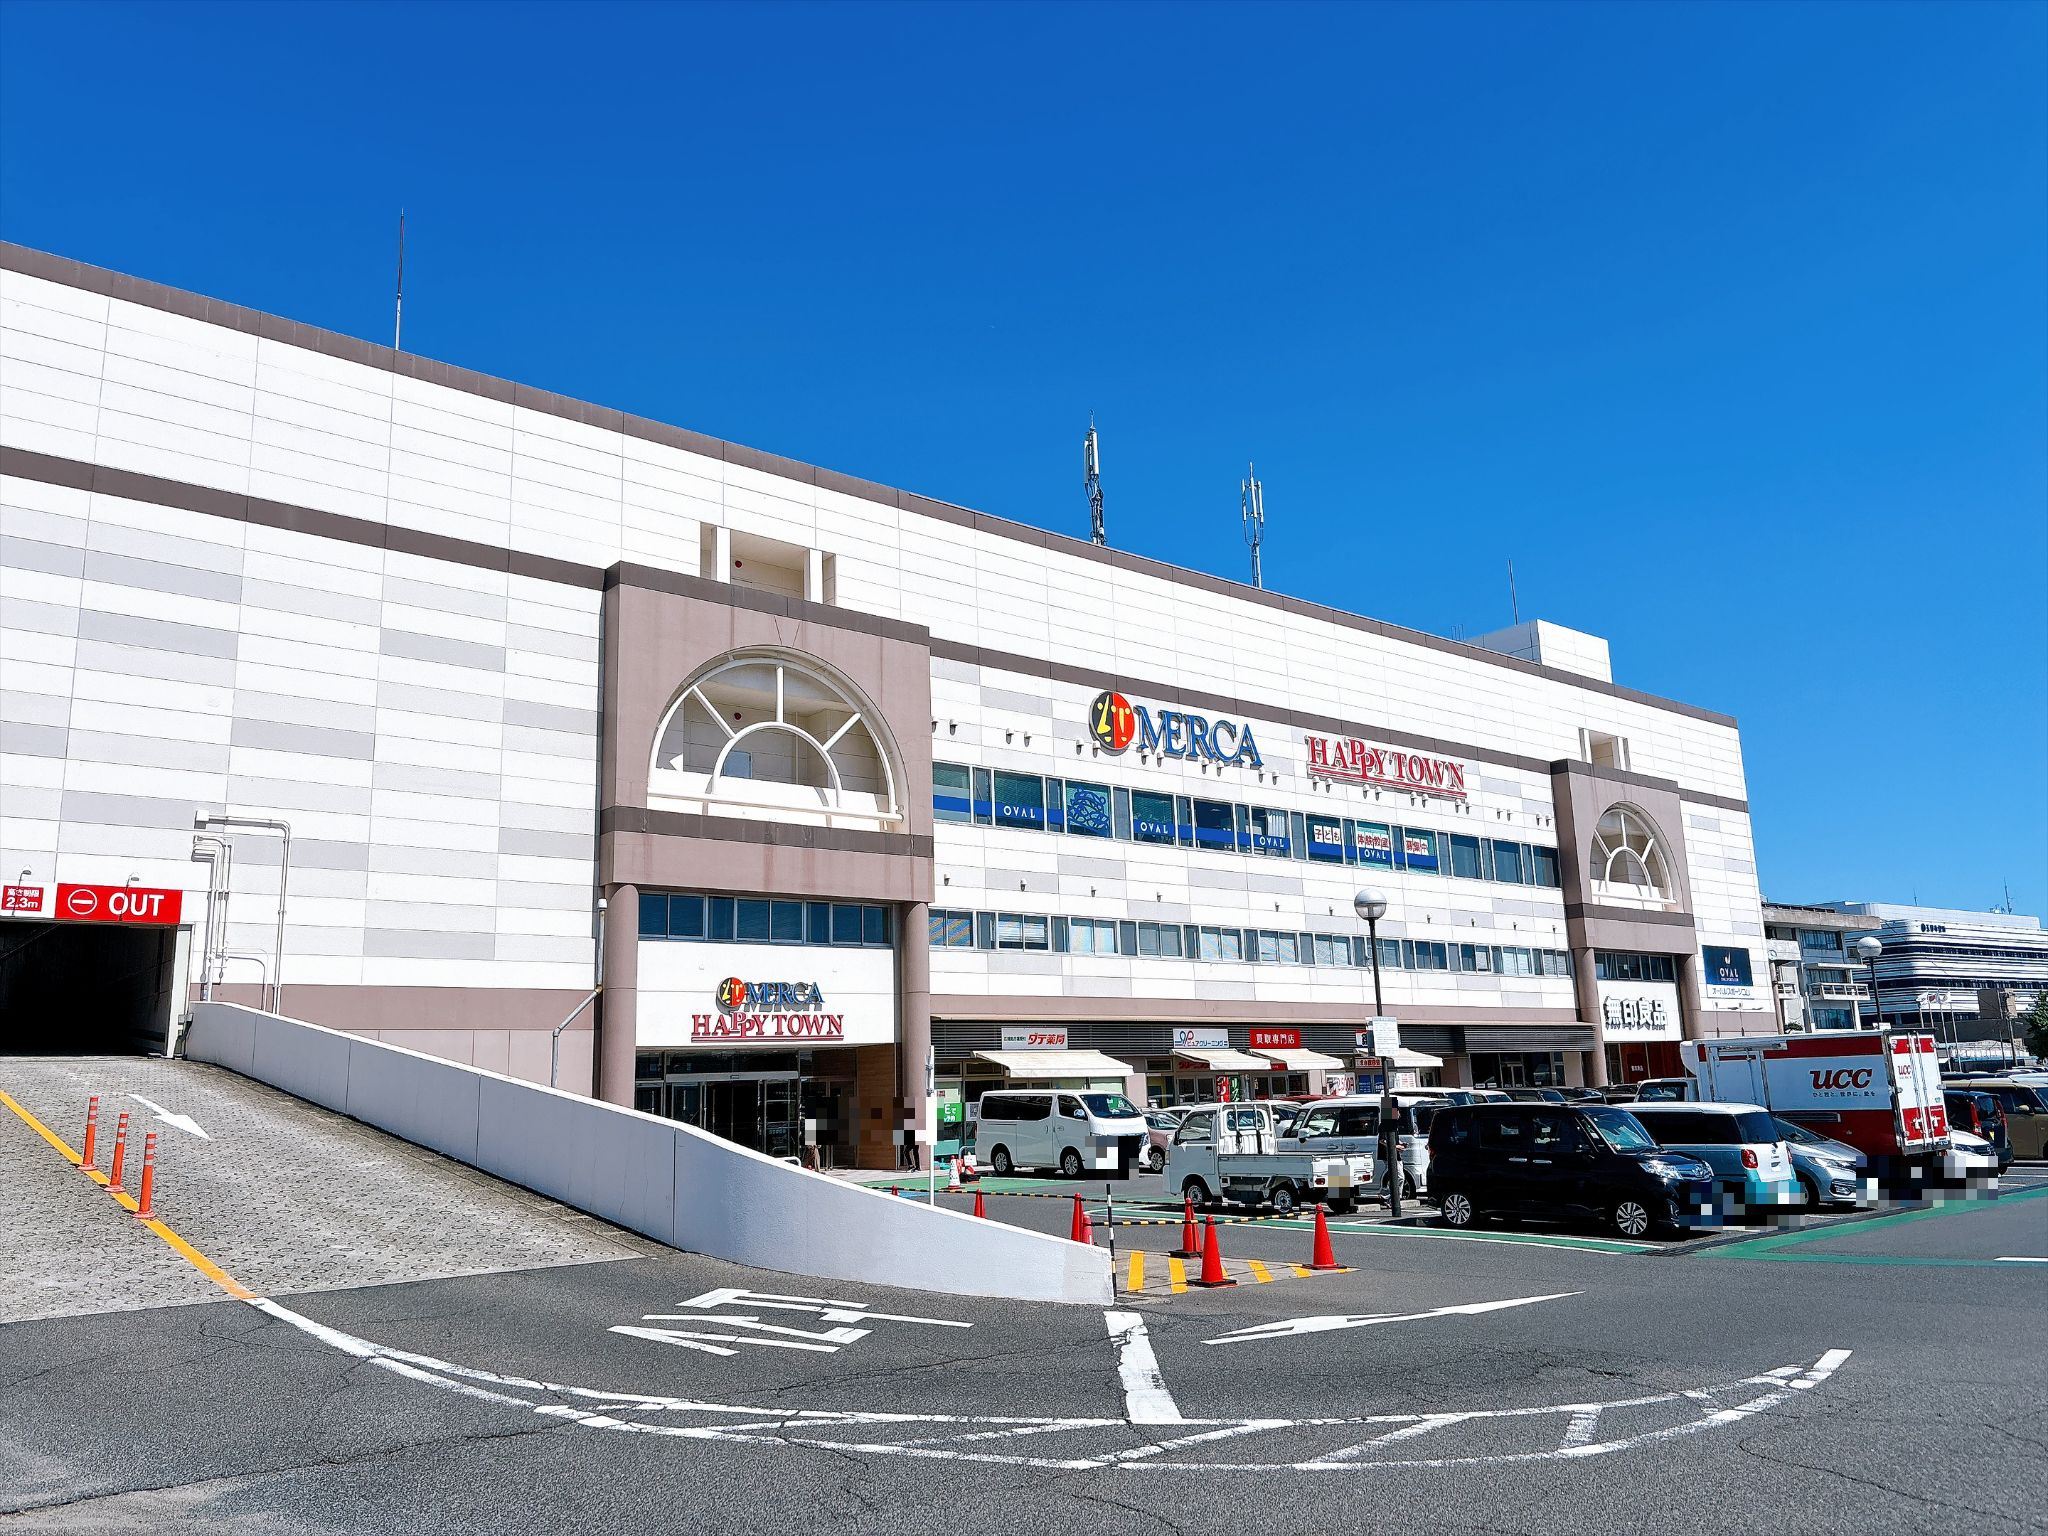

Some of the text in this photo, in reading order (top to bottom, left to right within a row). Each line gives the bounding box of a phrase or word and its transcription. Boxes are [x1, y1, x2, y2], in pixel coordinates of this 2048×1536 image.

[1134, 704, 1264, 766] MERCA
[1308, 735, 1466, 791] HAPPY TOWN
[1003, 805, 1036, 819] OVAL
[1140, 821, 1169, 834] OVAL
[1259, 836, 1285, 848] OVAL
[1314, 828, 1340, 842] 子ども
[1364, 848, 1387, 860] OVAL
[6, 897, 39, 908] 2.3m
[108, 892, 165, 917] OUT
[1719, 967, 1739, 978] OVAL
[744, 981, 826, 1006] MERCA
[1604, 997, 1668, 1029] 無印良品
[691, 1011, 844, 1038] HAPPY TOWN
[1256, 1033, 1295, 1045] 買取専門店
